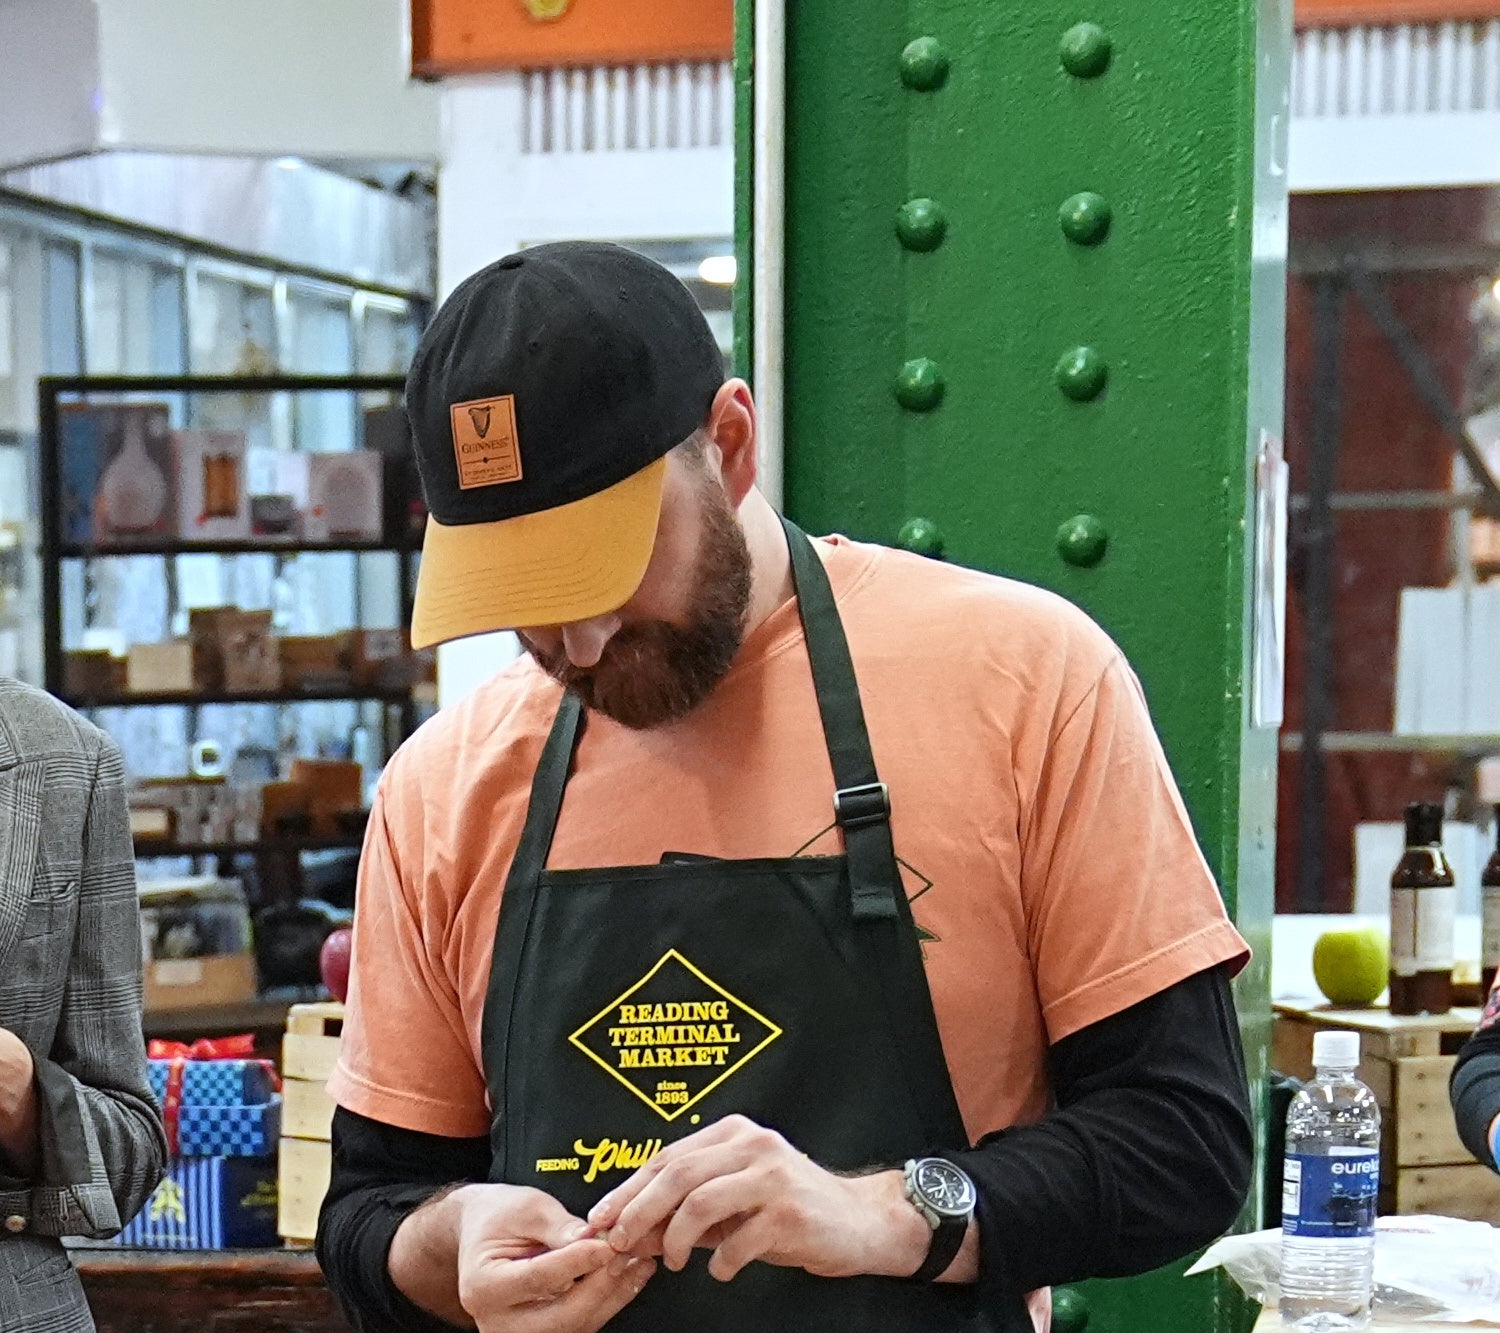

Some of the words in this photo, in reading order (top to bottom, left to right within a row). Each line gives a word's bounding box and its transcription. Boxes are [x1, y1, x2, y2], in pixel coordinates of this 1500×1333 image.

[461, 438, 509, 454] GUINNESS
[618, 1001, 729, 1024] READING
[608, 1024, 741, 1047] TERMINAL
[618, 1046, 729, 1068] MARKET
[657, 1080, 687, 1091] since
[655, 1091, 689, 1105] 1893
[535, 1157, 579, 1172] FEEDING
[573, 1138, 664, 1184] Phill
